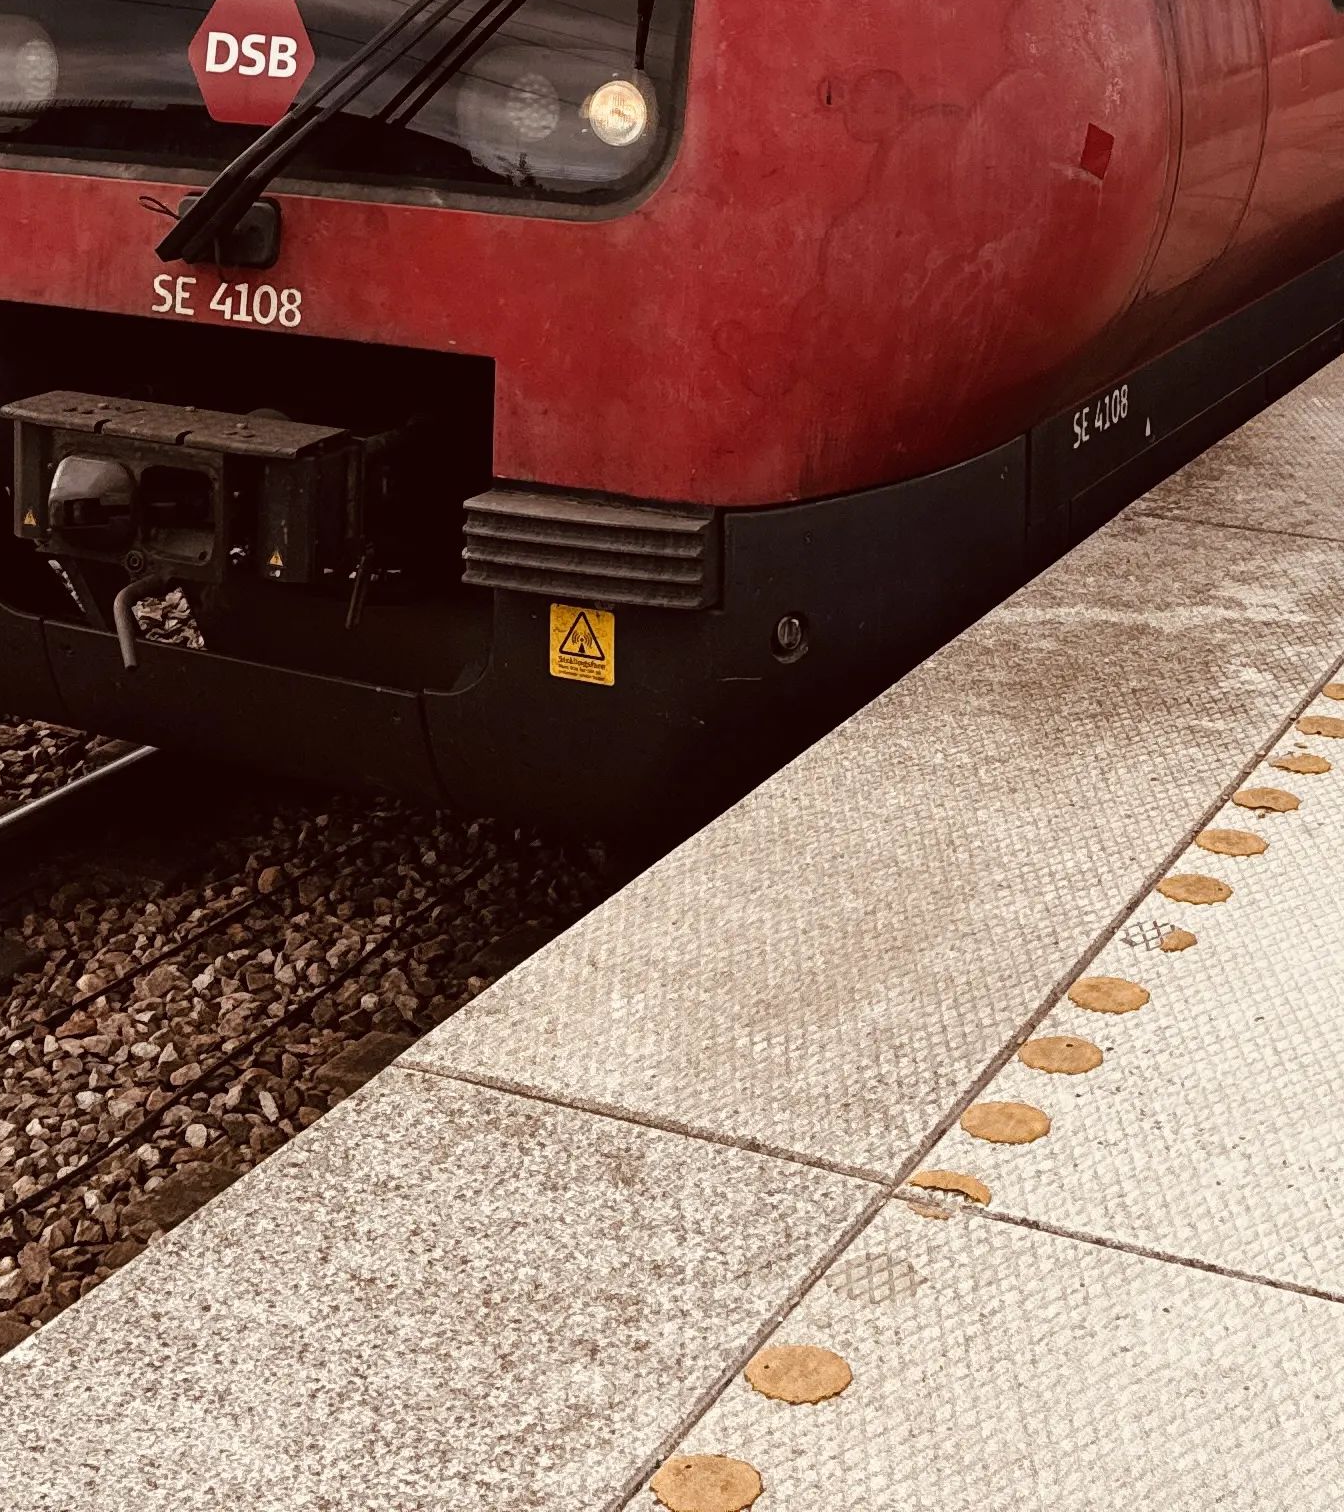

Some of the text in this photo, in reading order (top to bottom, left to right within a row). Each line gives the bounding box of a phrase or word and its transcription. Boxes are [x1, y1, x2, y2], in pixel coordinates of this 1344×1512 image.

[205, 31, 299, 78] DSB
[151, 273, 302, 328] SE 4108
[1073, 384, 1129, 449] SE 4108
